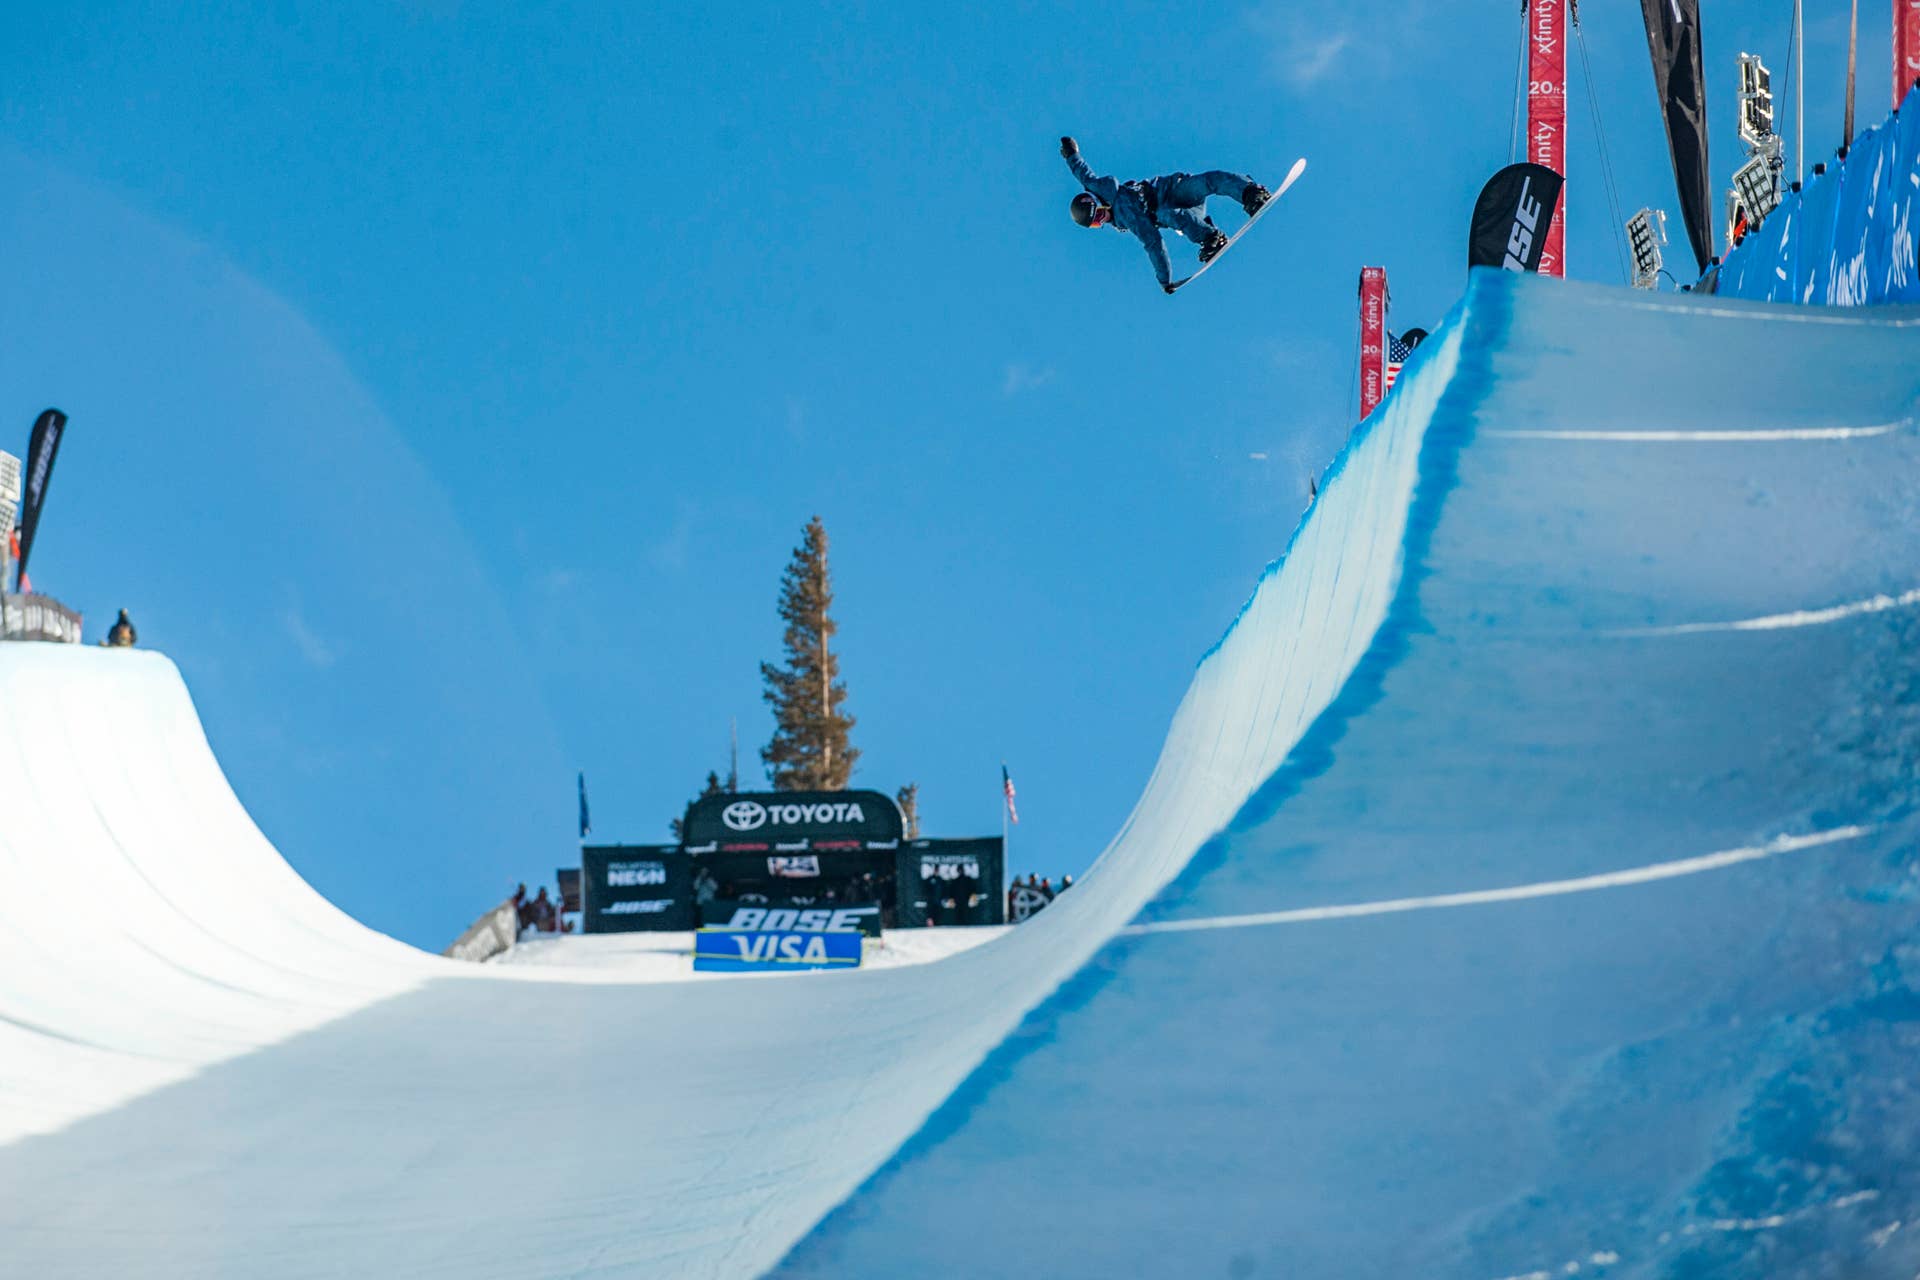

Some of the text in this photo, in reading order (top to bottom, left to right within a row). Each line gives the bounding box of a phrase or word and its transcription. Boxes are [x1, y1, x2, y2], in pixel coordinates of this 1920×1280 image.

[1532, 0, 1557, 54] xfinity
[1533, 121, 1557, 170] inity
[1502, 175, 1542, 271] SE
[1367, 293, 1380, 330] xfinity
[1364, 368, 1380, 406] xfinity
[768, 803, 866, 825] TOYOTA
[704, 907, 880, 932] BOSE
[730, 935, 829, 964] VISA
